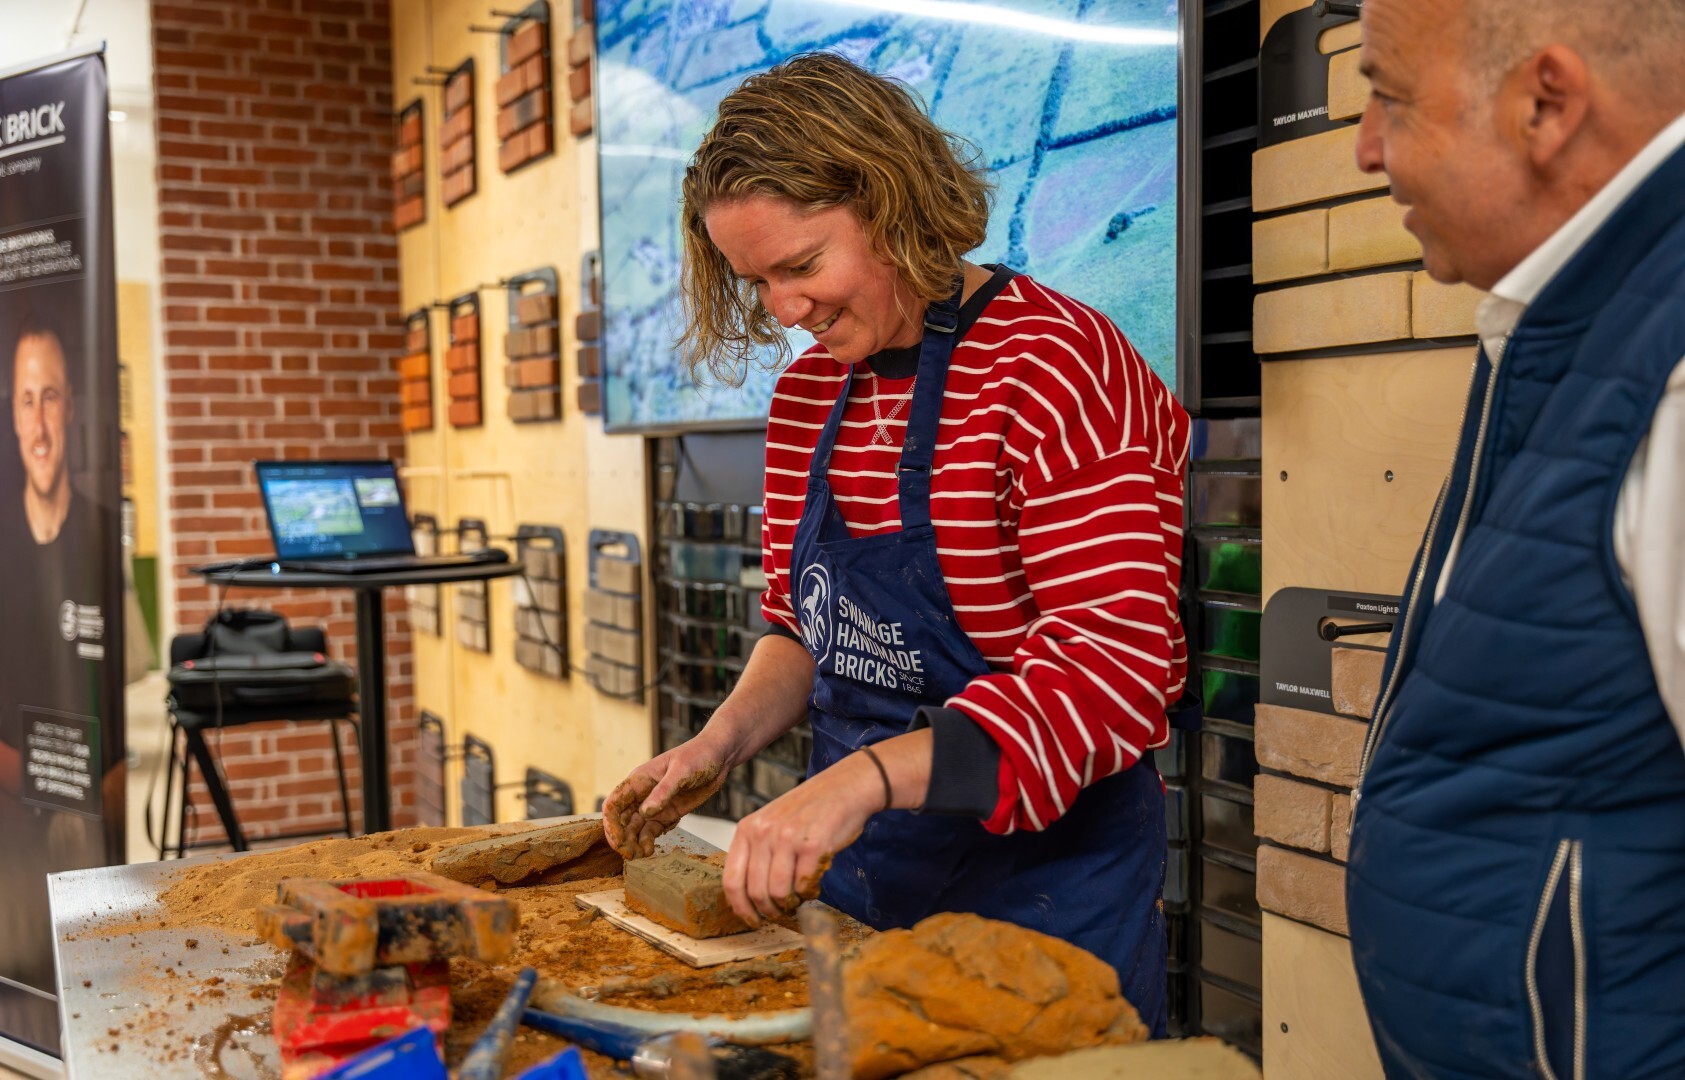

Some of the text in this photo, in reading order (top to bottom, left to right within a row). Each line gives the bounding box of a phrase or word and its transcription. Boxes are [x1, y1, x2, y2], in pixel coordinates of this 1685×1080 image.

[6, 100, 65, 145] BRICK
[1273, 106, 1329, 127] TAYLOR MAXWELL
[1356, 602, 1378, 612] Paxton
[1378, 604, 1394, 615] Light
[838, 595, 905, 646] SWANAGE
[836, 622, 924, 673] HANDMADE
[834, 651, 898, 689] BRICKS
[898, 671, 925, 686] SINCE
[902, 682, 922, 694] 1865
[1275, 682, 1331, 699] TAYLOR MAXWELL
